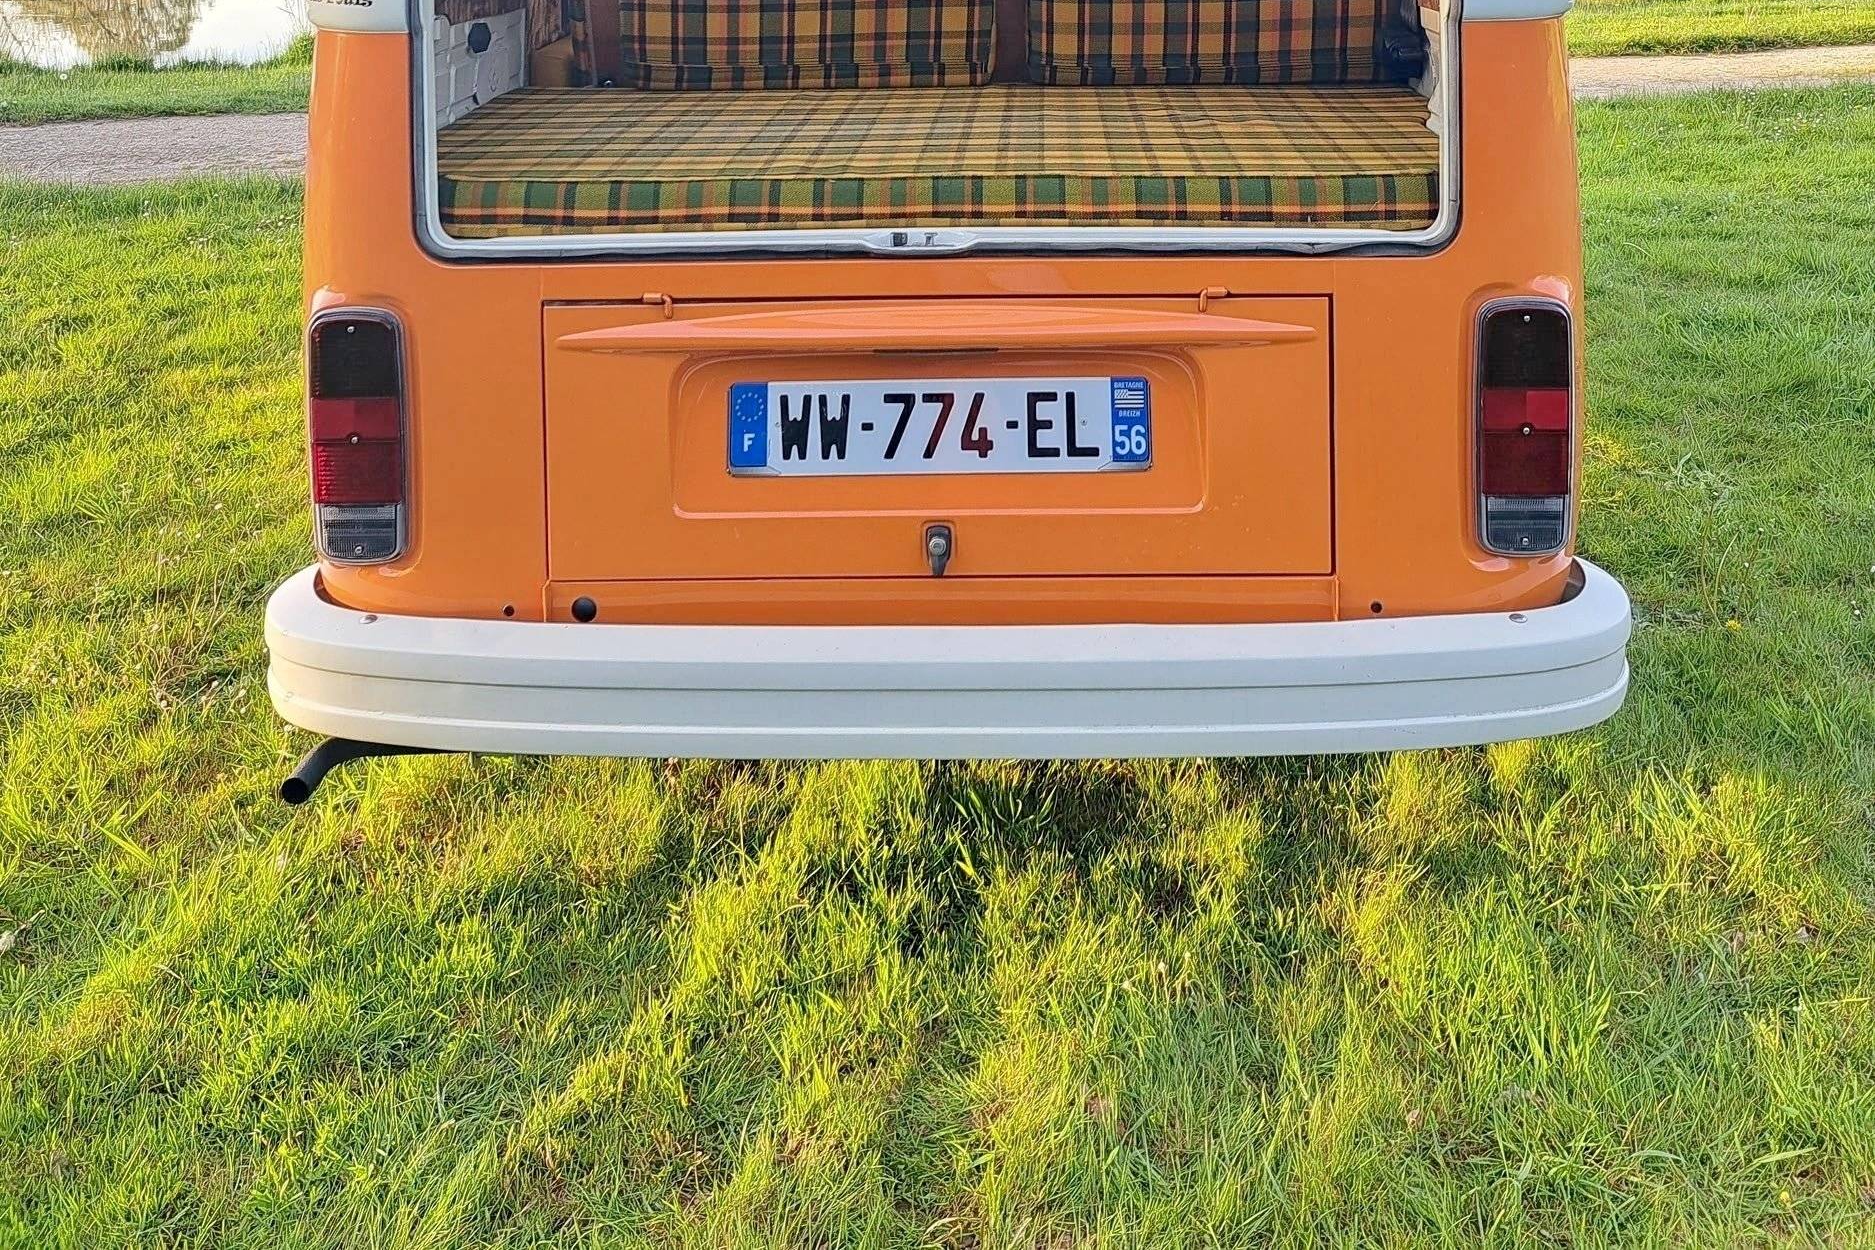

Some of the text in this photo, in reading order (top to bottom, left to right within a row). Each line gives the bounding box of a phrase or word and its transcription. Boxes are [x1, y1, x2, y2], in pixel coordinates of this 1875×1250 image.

[1113, 381, 1144, 389] BRETAGNE
[779, 391, 1100, 461] WW-774-EL
[743, 433, 755, 453] F
[1114, 424, 1147, 456] 56
